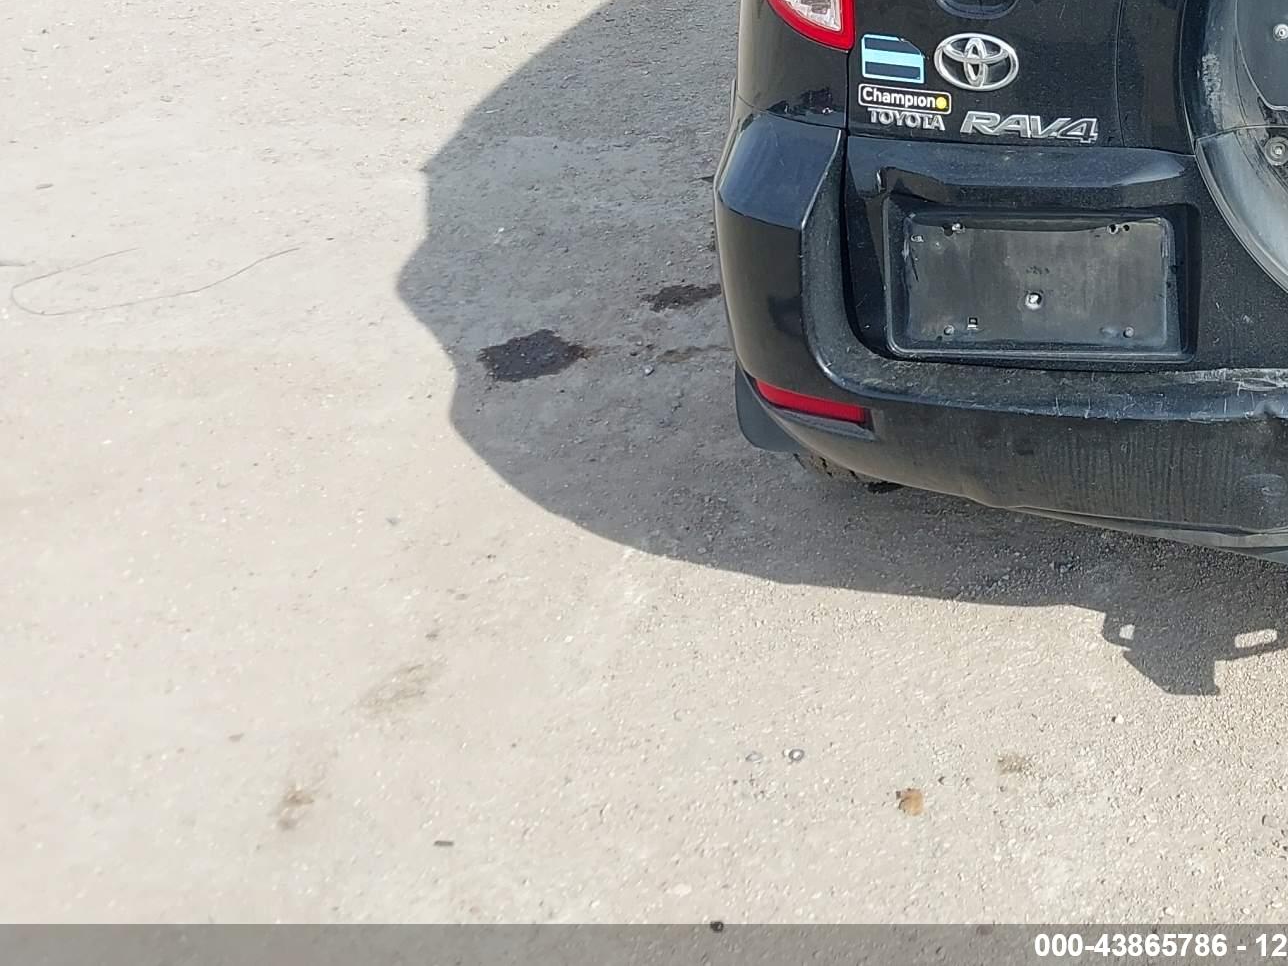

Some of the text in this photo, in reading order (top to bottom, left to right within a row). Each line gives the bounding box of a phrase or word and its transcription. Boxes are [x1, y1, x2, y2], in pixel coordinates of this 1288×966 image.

[862, 87, 935, 109] Champion
[867, 107, 946, 130] TOYOTA
[960, 110, 1099, 144] RAV4
